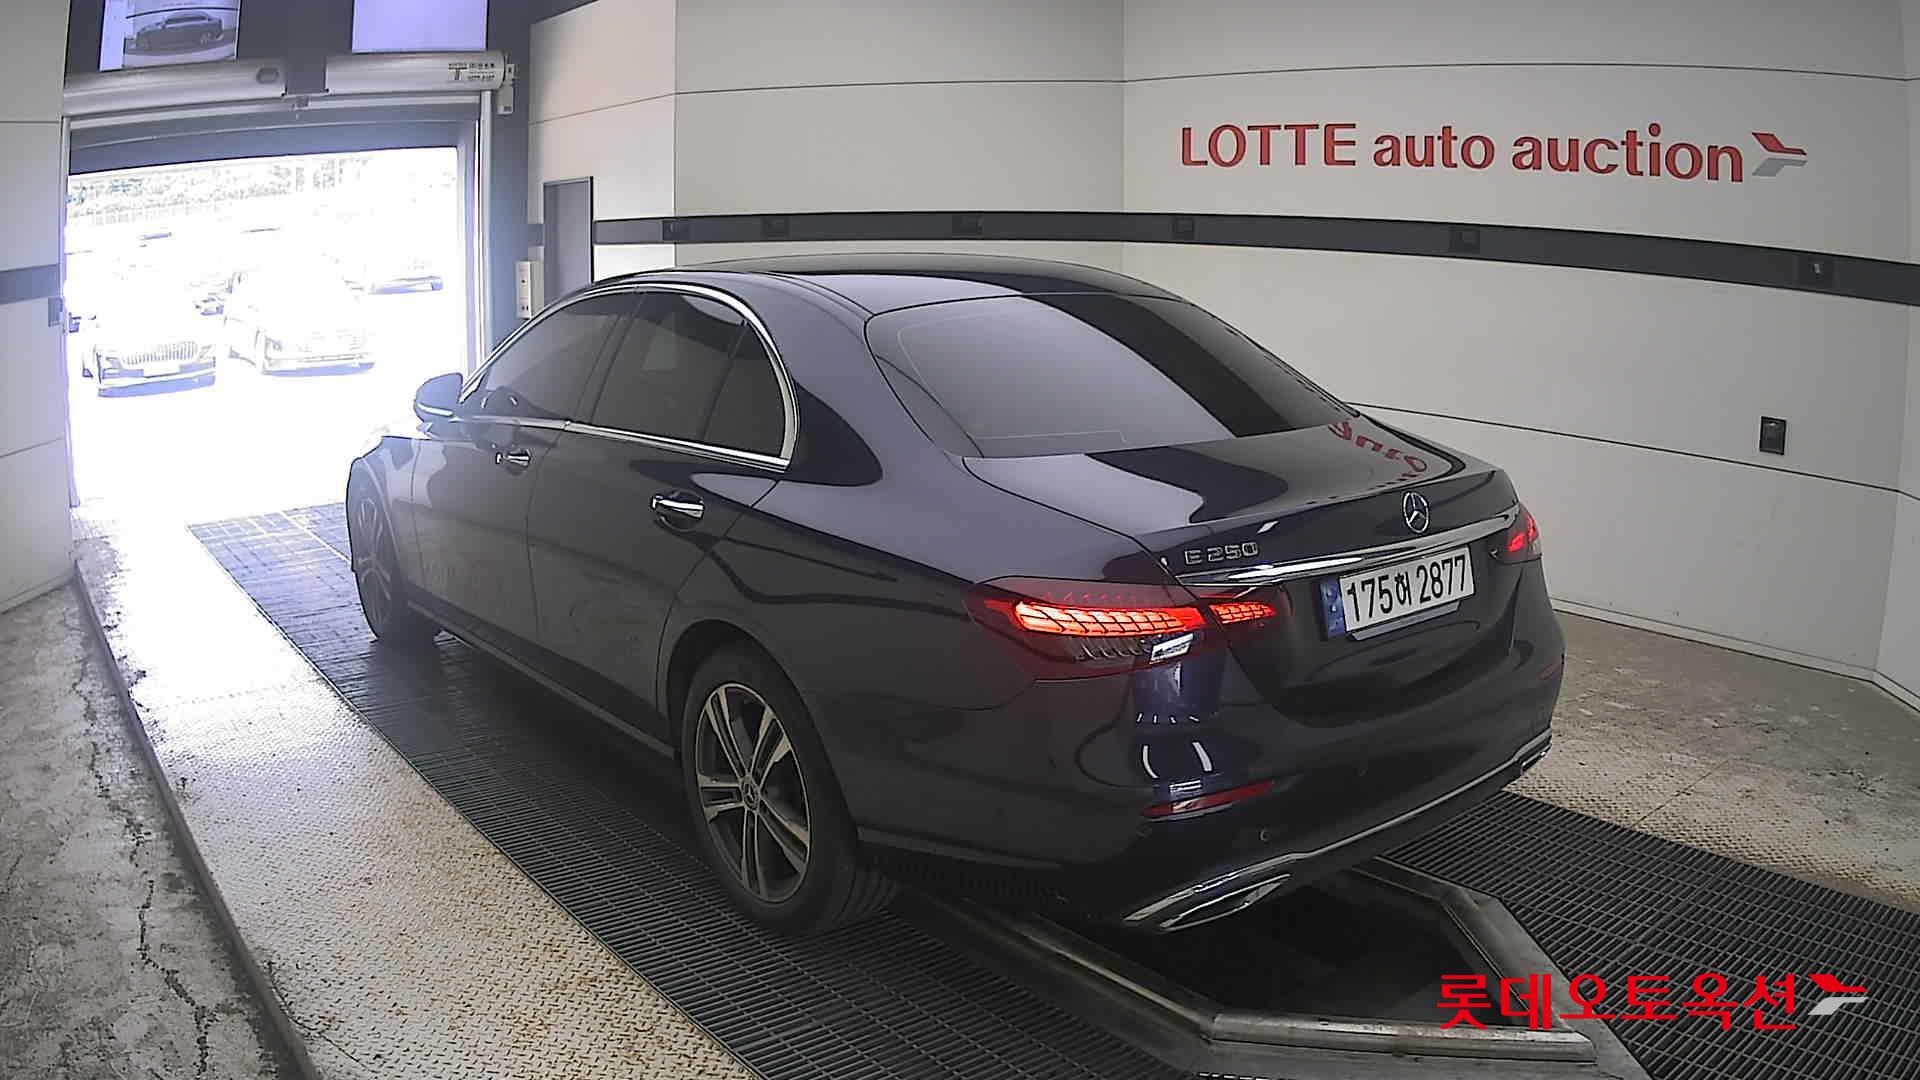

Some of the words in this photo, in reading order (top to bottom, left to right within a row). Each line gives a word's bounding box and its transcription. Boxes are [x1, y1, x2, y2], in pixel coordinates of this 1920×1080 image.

[1181, 122, 1357, 168] LOTTE
[1374, 126, 1496, 170] auto
[1511, 122, 1744, 183] auction
[1184, 549, 1202, 565] E
[1207, 542, 1259, 562] 250
[1347, 571, 1412, 622] 175허
[1416, 554, 1466, 603] 2877
